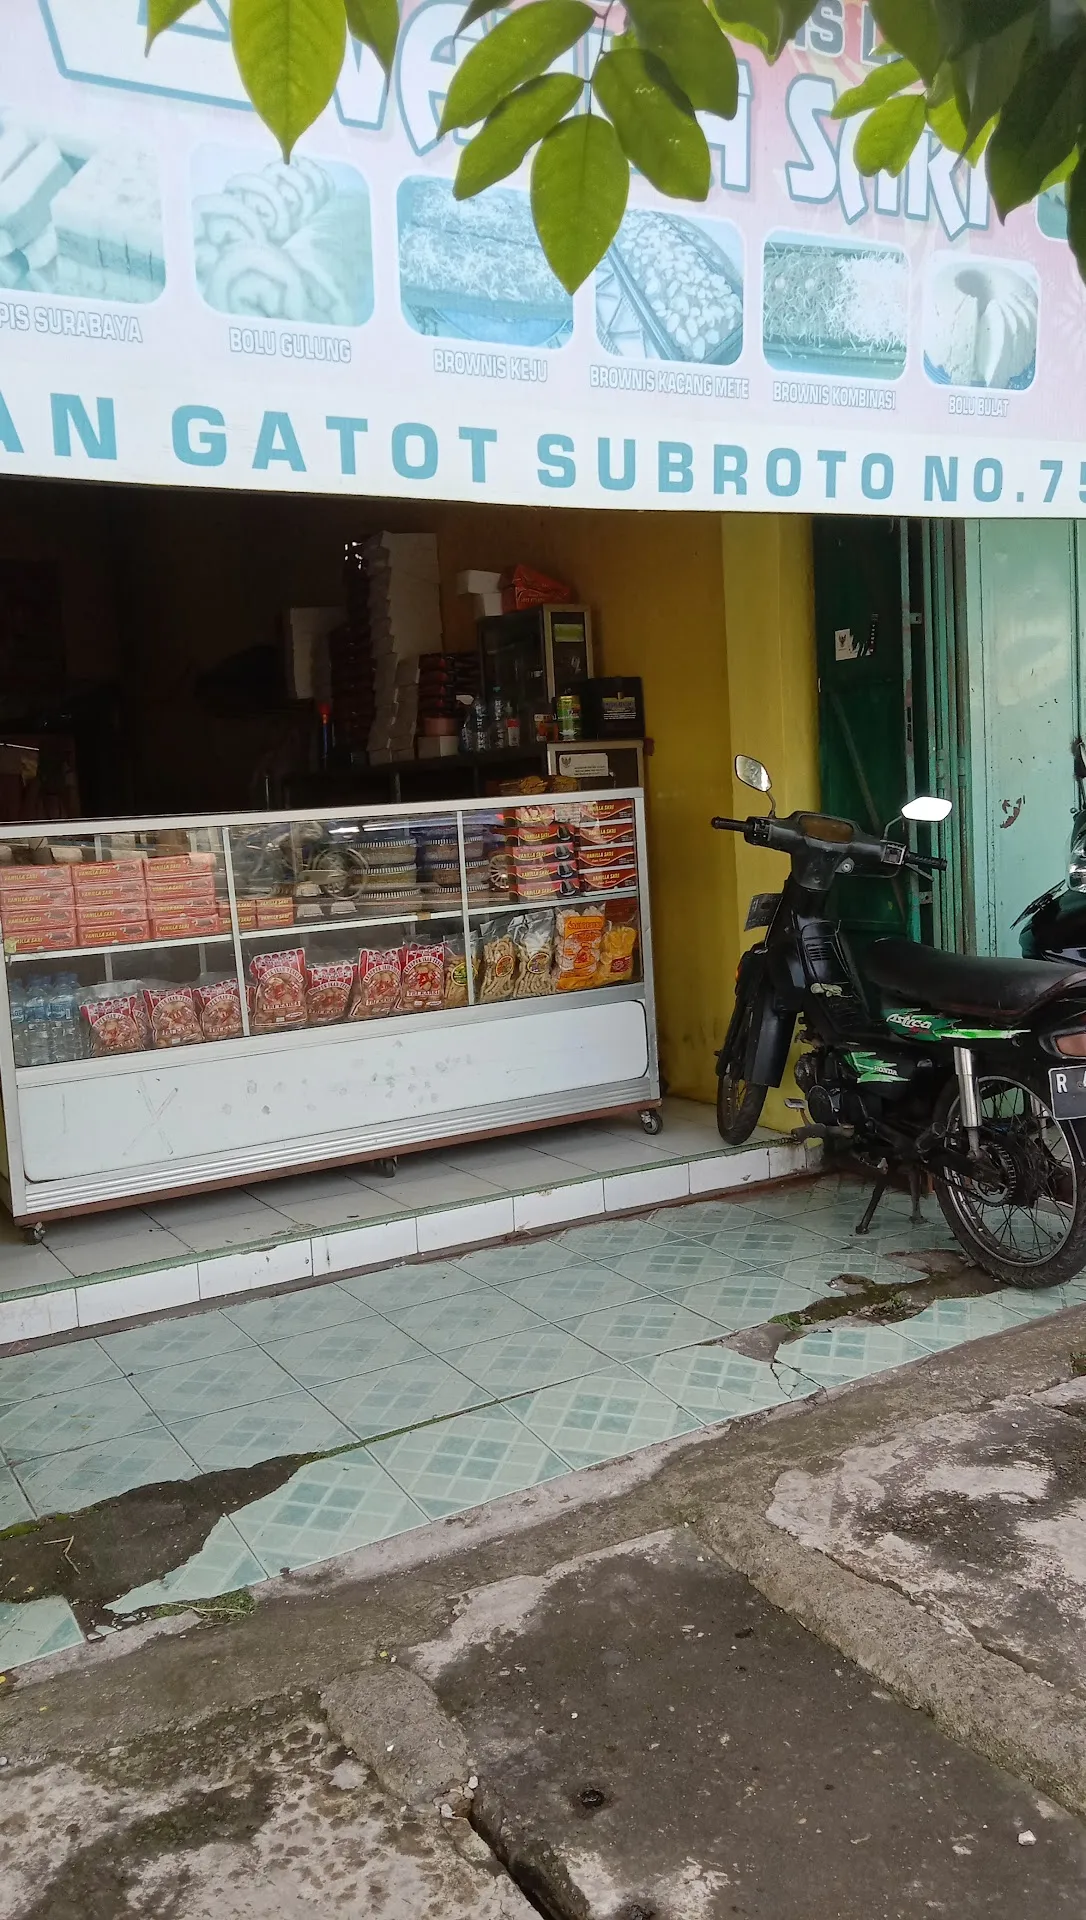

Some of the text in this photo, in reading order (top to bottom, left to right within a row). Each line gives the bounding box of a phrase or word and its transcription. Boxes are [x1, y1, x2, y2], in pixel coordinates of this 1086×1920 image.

[34, 306, 144, 343] SURABAYA
[228, 326, 352, 364] BOLU GULUNG
[432, 348, 548, 383] BROWNIS KEJU
[589, 364, 750, 400] BROWNIS KACANG METE
[772, 381, 896, 411] BROWNIS KOMBINASI
[948, 395, 1010, 418] BOLU BULAT
[170, 404, 498, 484] GATOT
[536, 432, 895, 502] SUBROTO
[873, 1065, 899, 1077] HONDA
[1055, 1073, 1068, 1094] R
